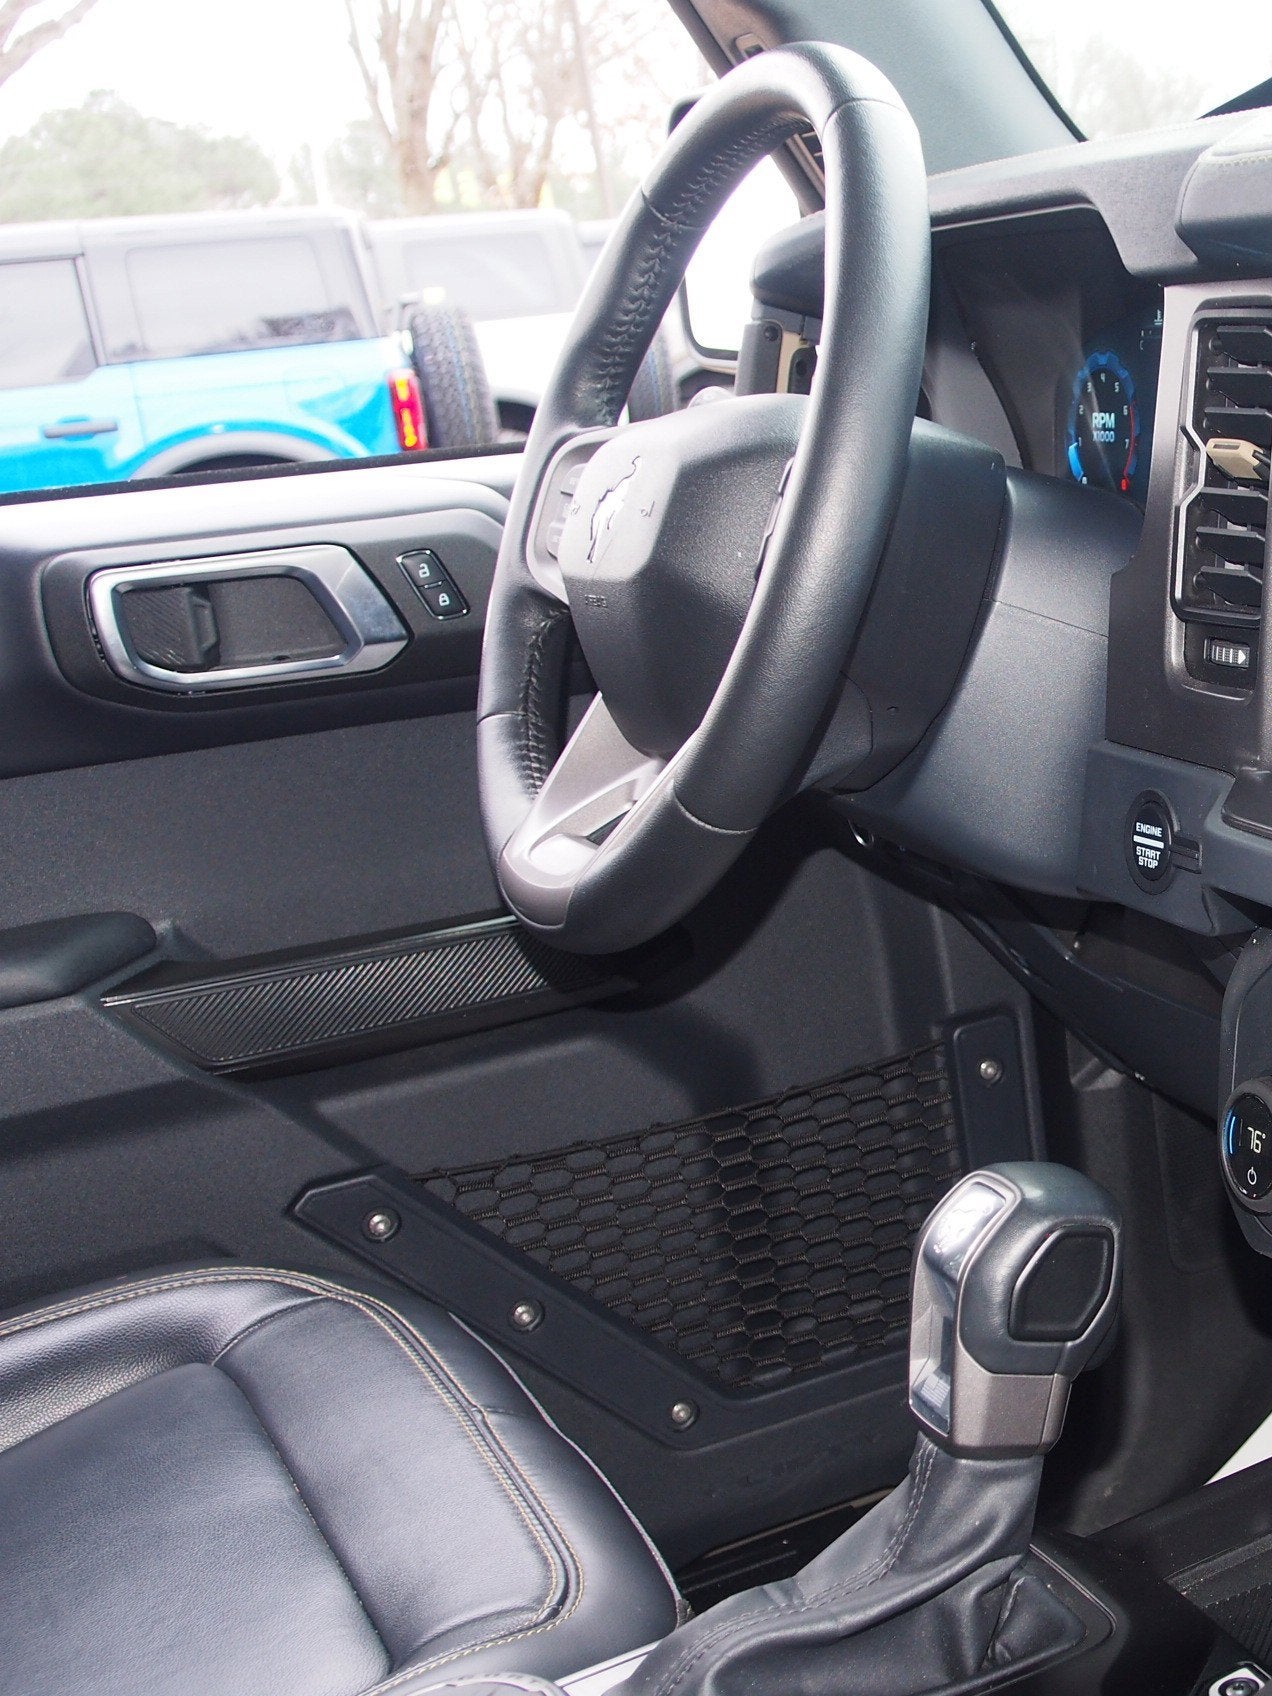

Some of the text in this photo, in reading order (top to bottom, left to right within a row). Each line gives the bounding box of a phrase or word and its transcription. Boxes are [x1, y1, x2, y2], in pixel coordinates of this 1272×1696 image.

[1100, 372, 1106, 383] 4
[1086, 382, 1092, 393] 3
[1114, 382, 1120, 393] 5
[1123, 405, 1128, 416] 6
[1092, 412, 1116, 429] RPM
[1092, 430, 1116, 443] X1000
[1135, 821, 1163, 838] ENGINE
[1135, 845, 1162, 861] START
[1138, 855, 1159, 869] STOP
[1246, 1125, 1267, 1154] 76°
